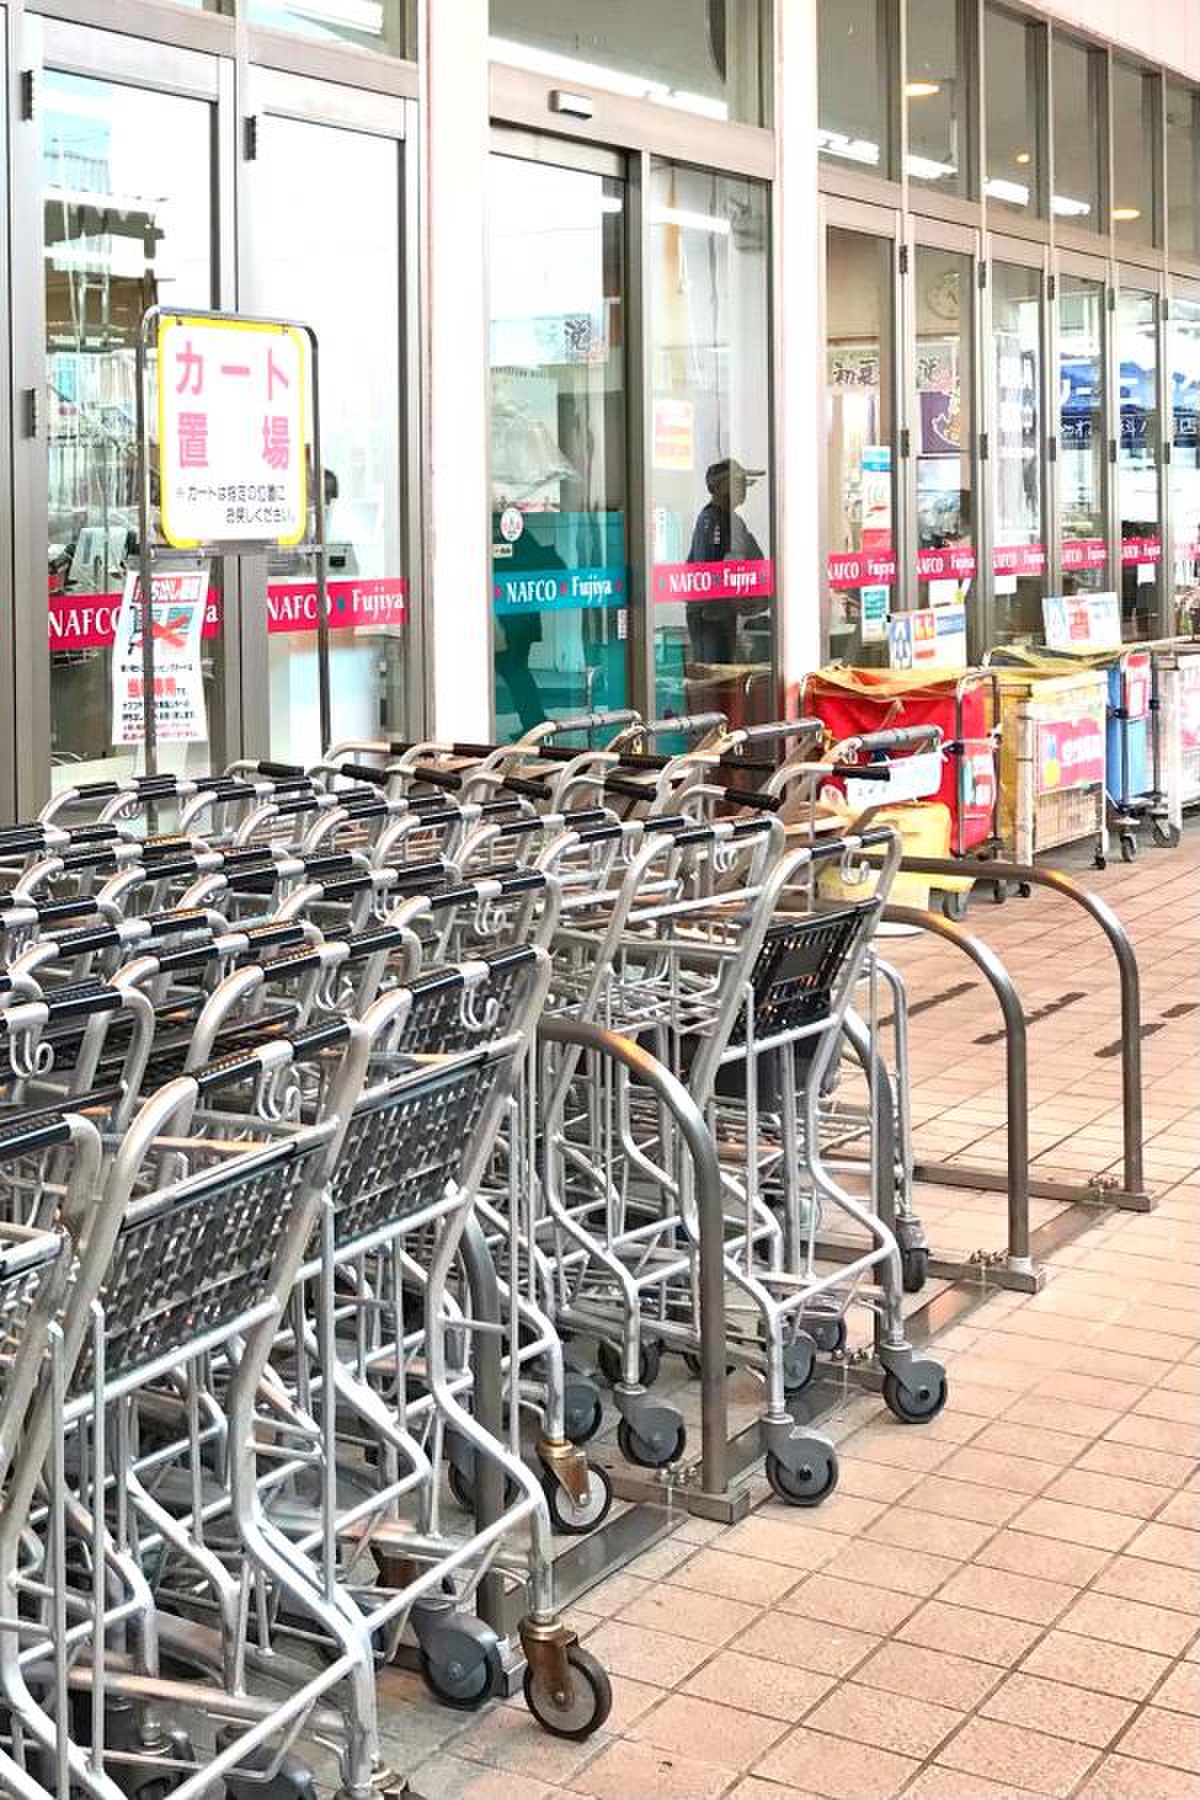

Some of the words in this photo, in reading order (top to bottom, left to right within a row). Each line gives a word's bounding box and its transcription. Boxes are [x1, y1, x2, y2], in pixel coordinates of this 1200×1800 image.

[176, 340, 289, 401] カート
[177, 412, 290, 470] 置場
[506, 579, 557, 604] NAFCO
[571, 573, 613, 605] Fujiya
[668, 571, 713, 593] NAFCO
[723, 565, 758, 595] Fujiya
[352, 586, 405, 620] Fujiya
